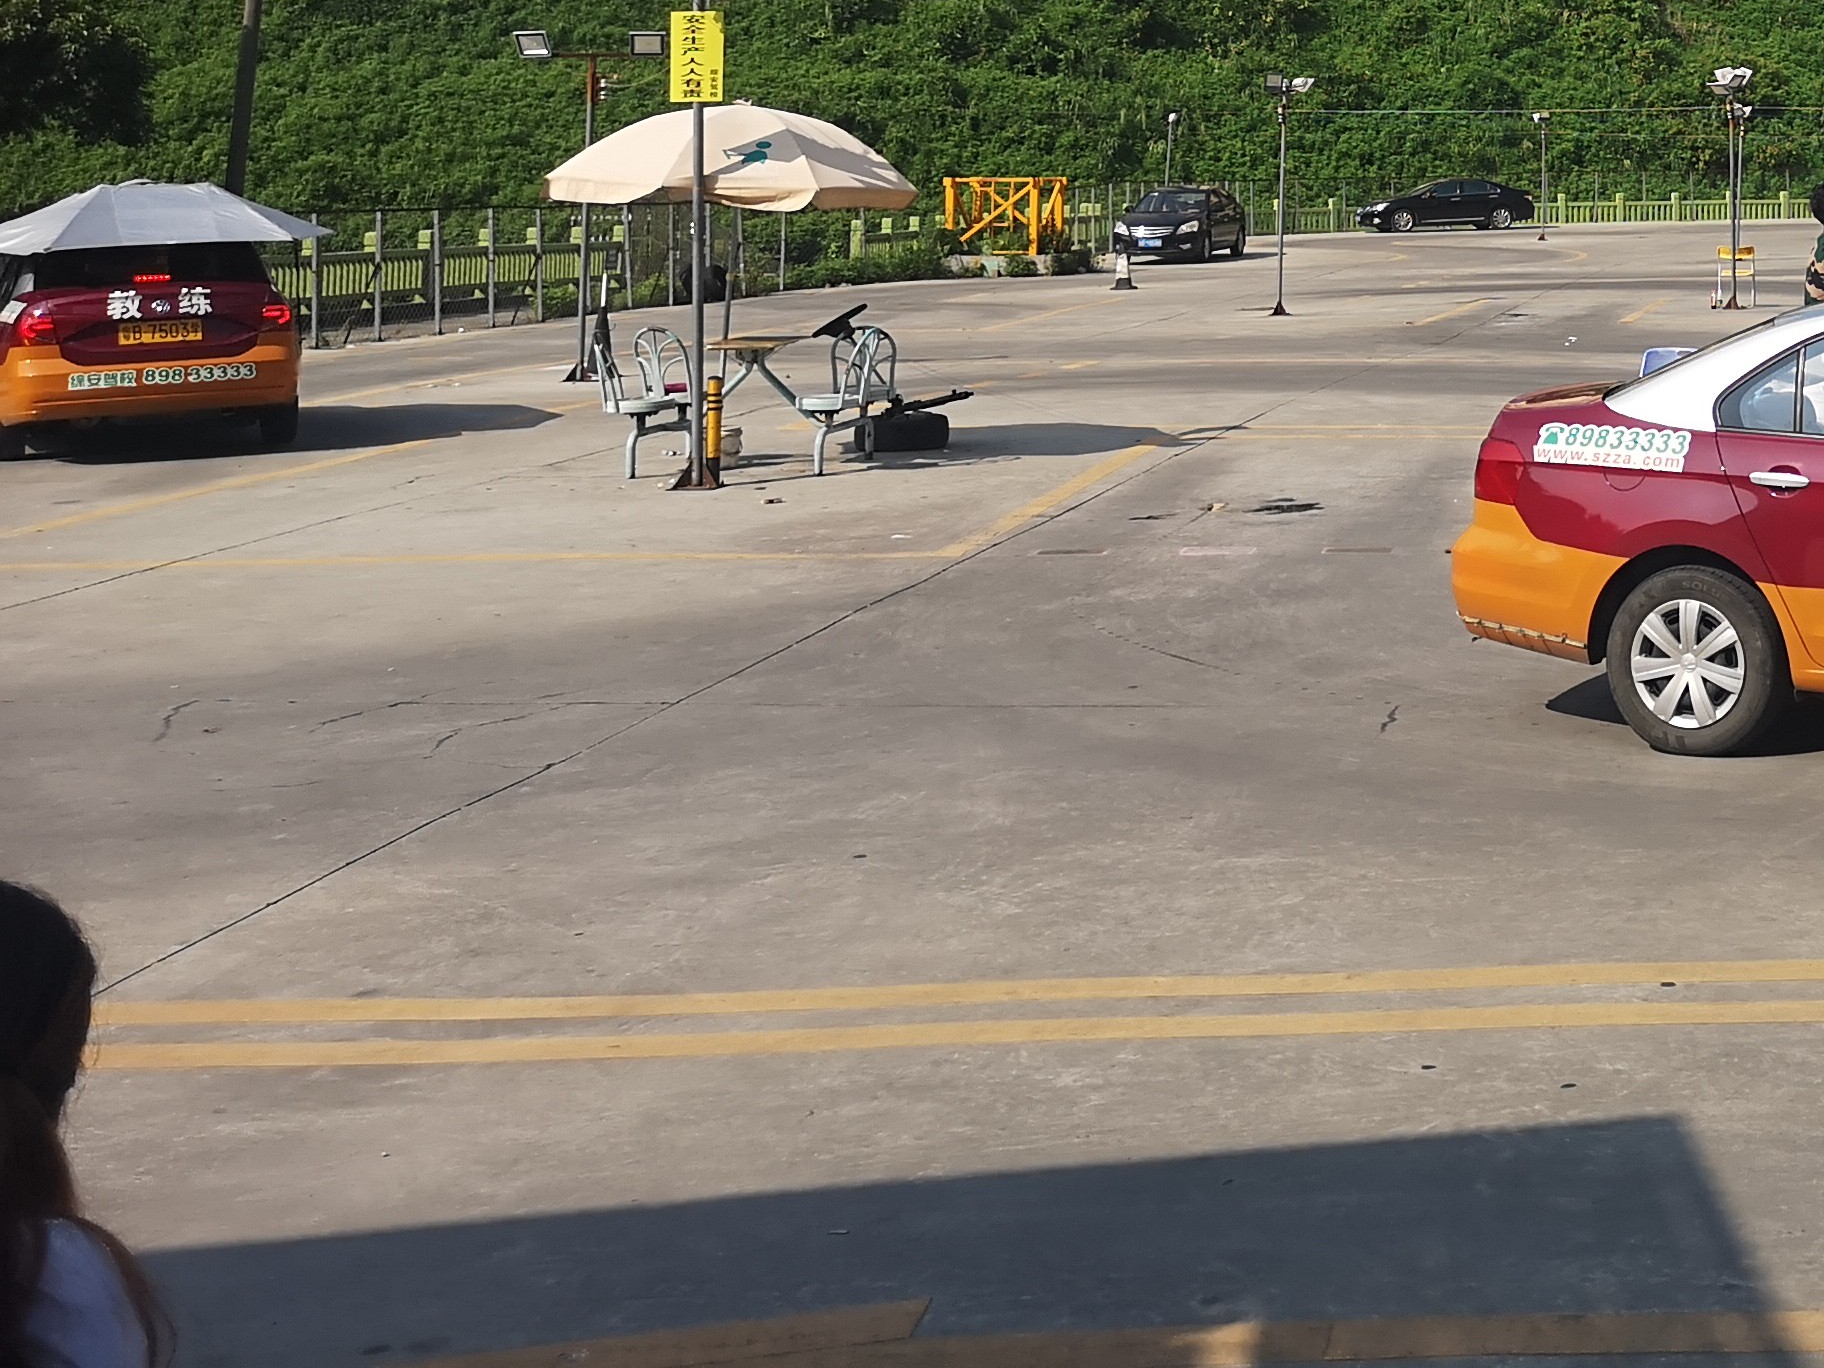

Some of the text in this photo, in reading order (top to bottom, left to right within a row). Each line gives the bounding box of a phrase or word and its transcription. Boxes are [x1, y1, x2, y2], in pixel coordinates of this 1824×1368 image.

[681, 15, 705, 98] 安全生产人人有责
[1565, 427, 1687, 455] 89833333
